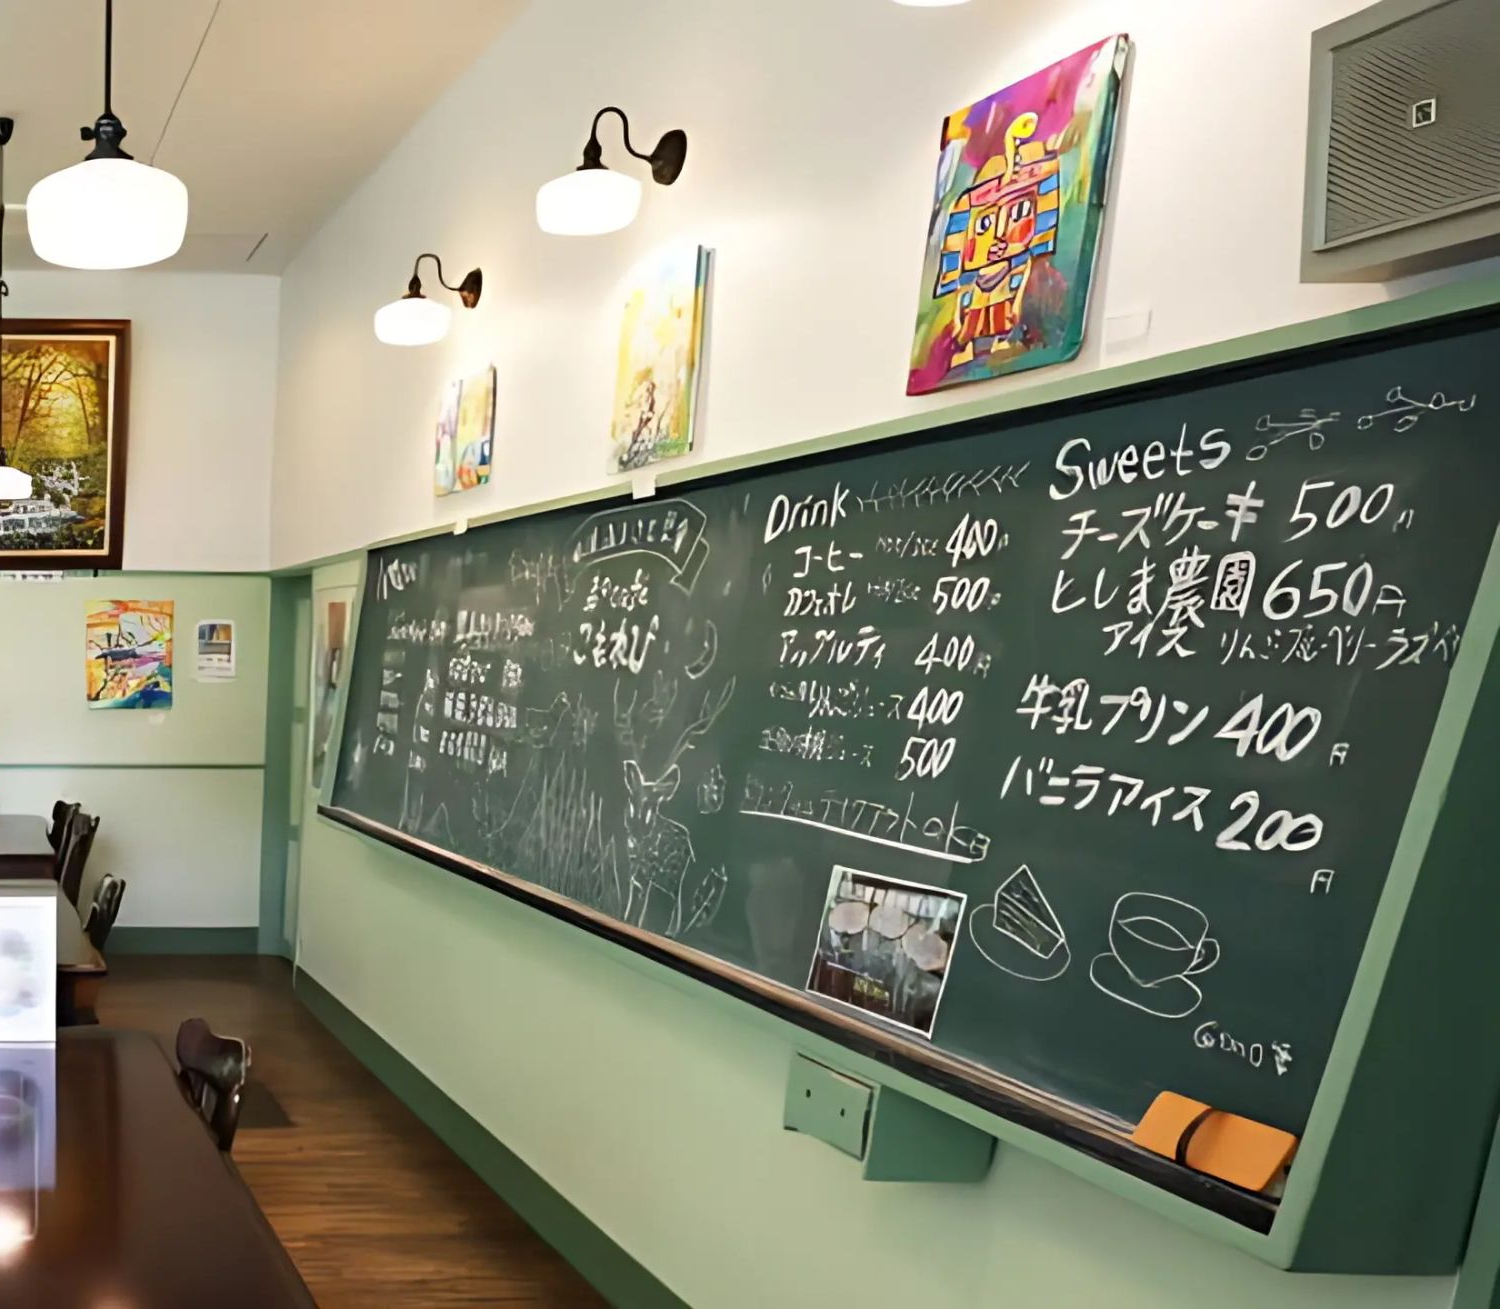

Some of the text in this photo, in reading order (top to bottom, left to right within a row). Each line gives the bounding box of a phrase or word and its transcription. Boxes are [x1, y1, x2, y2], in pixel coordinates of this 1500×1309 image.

[1049, 423, 1231, 500] Sweets
[764, 481, 849, 544] Drink
[1061, 480, 1265, 560] チーズケーキ
[793, 540, 863, 578] コーヒー
[1052, 545, 1256, 628] としま農園
[1102, 620, 1197, 659] アイス
[906, 686, 965, 731] 400
[1016, 674, 1209, 746] 牛乳プリン
[894, 736, 957, 782] 500
[1000, 755, 1324, 852] バニラアイス 200
